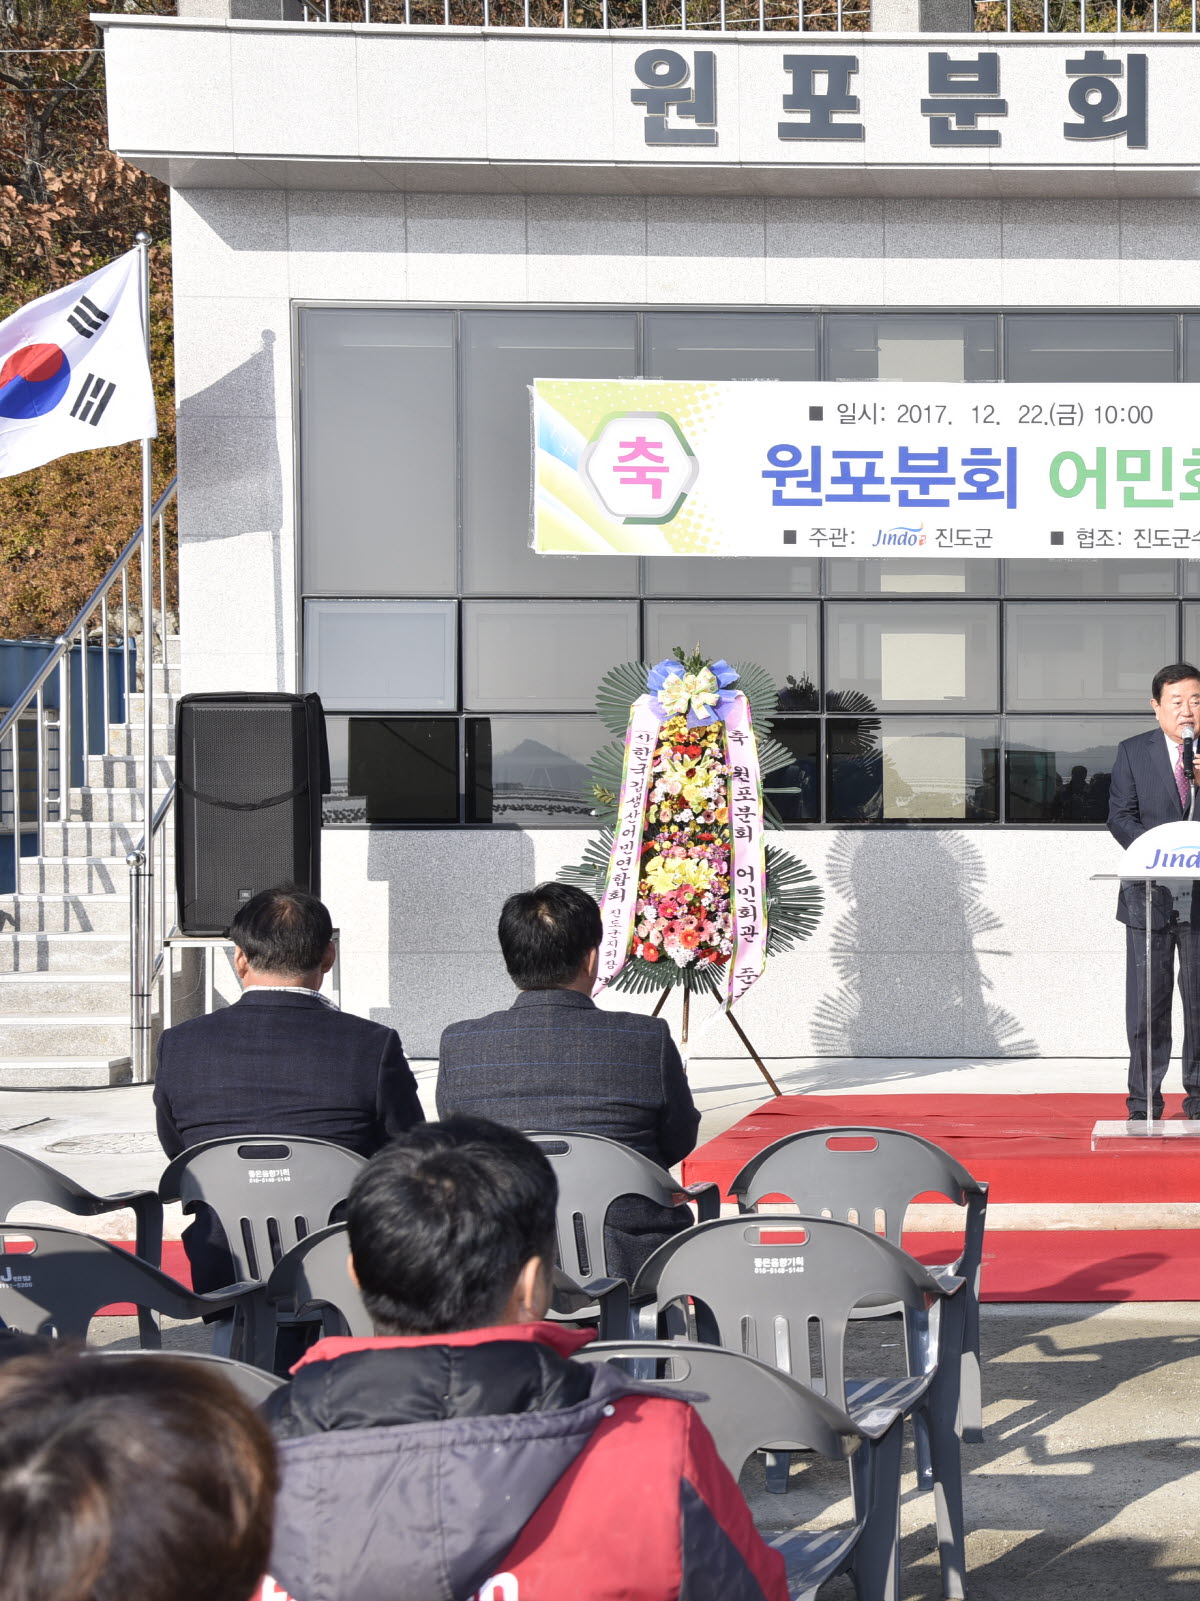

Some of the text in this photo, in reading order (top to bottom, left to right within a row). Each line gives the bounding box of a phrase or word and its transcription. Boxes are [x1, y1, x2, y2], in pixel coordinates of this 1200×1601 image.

[837, 402, 1154, 427] 일시: 2017. 12. 22.(금) 10:00
[612, 436, 670, 500] 축
[761, 444, 1018, 511] 원포분회
[808, 527, 994, 549] 주관: Jindo 진도군
[1076, 527, 1122, 550] 협조:
[728, 729, 749, 746] 축
[733, 765, 756, 843] 원포분회
[736, 865, 760, 943] 어민회관
